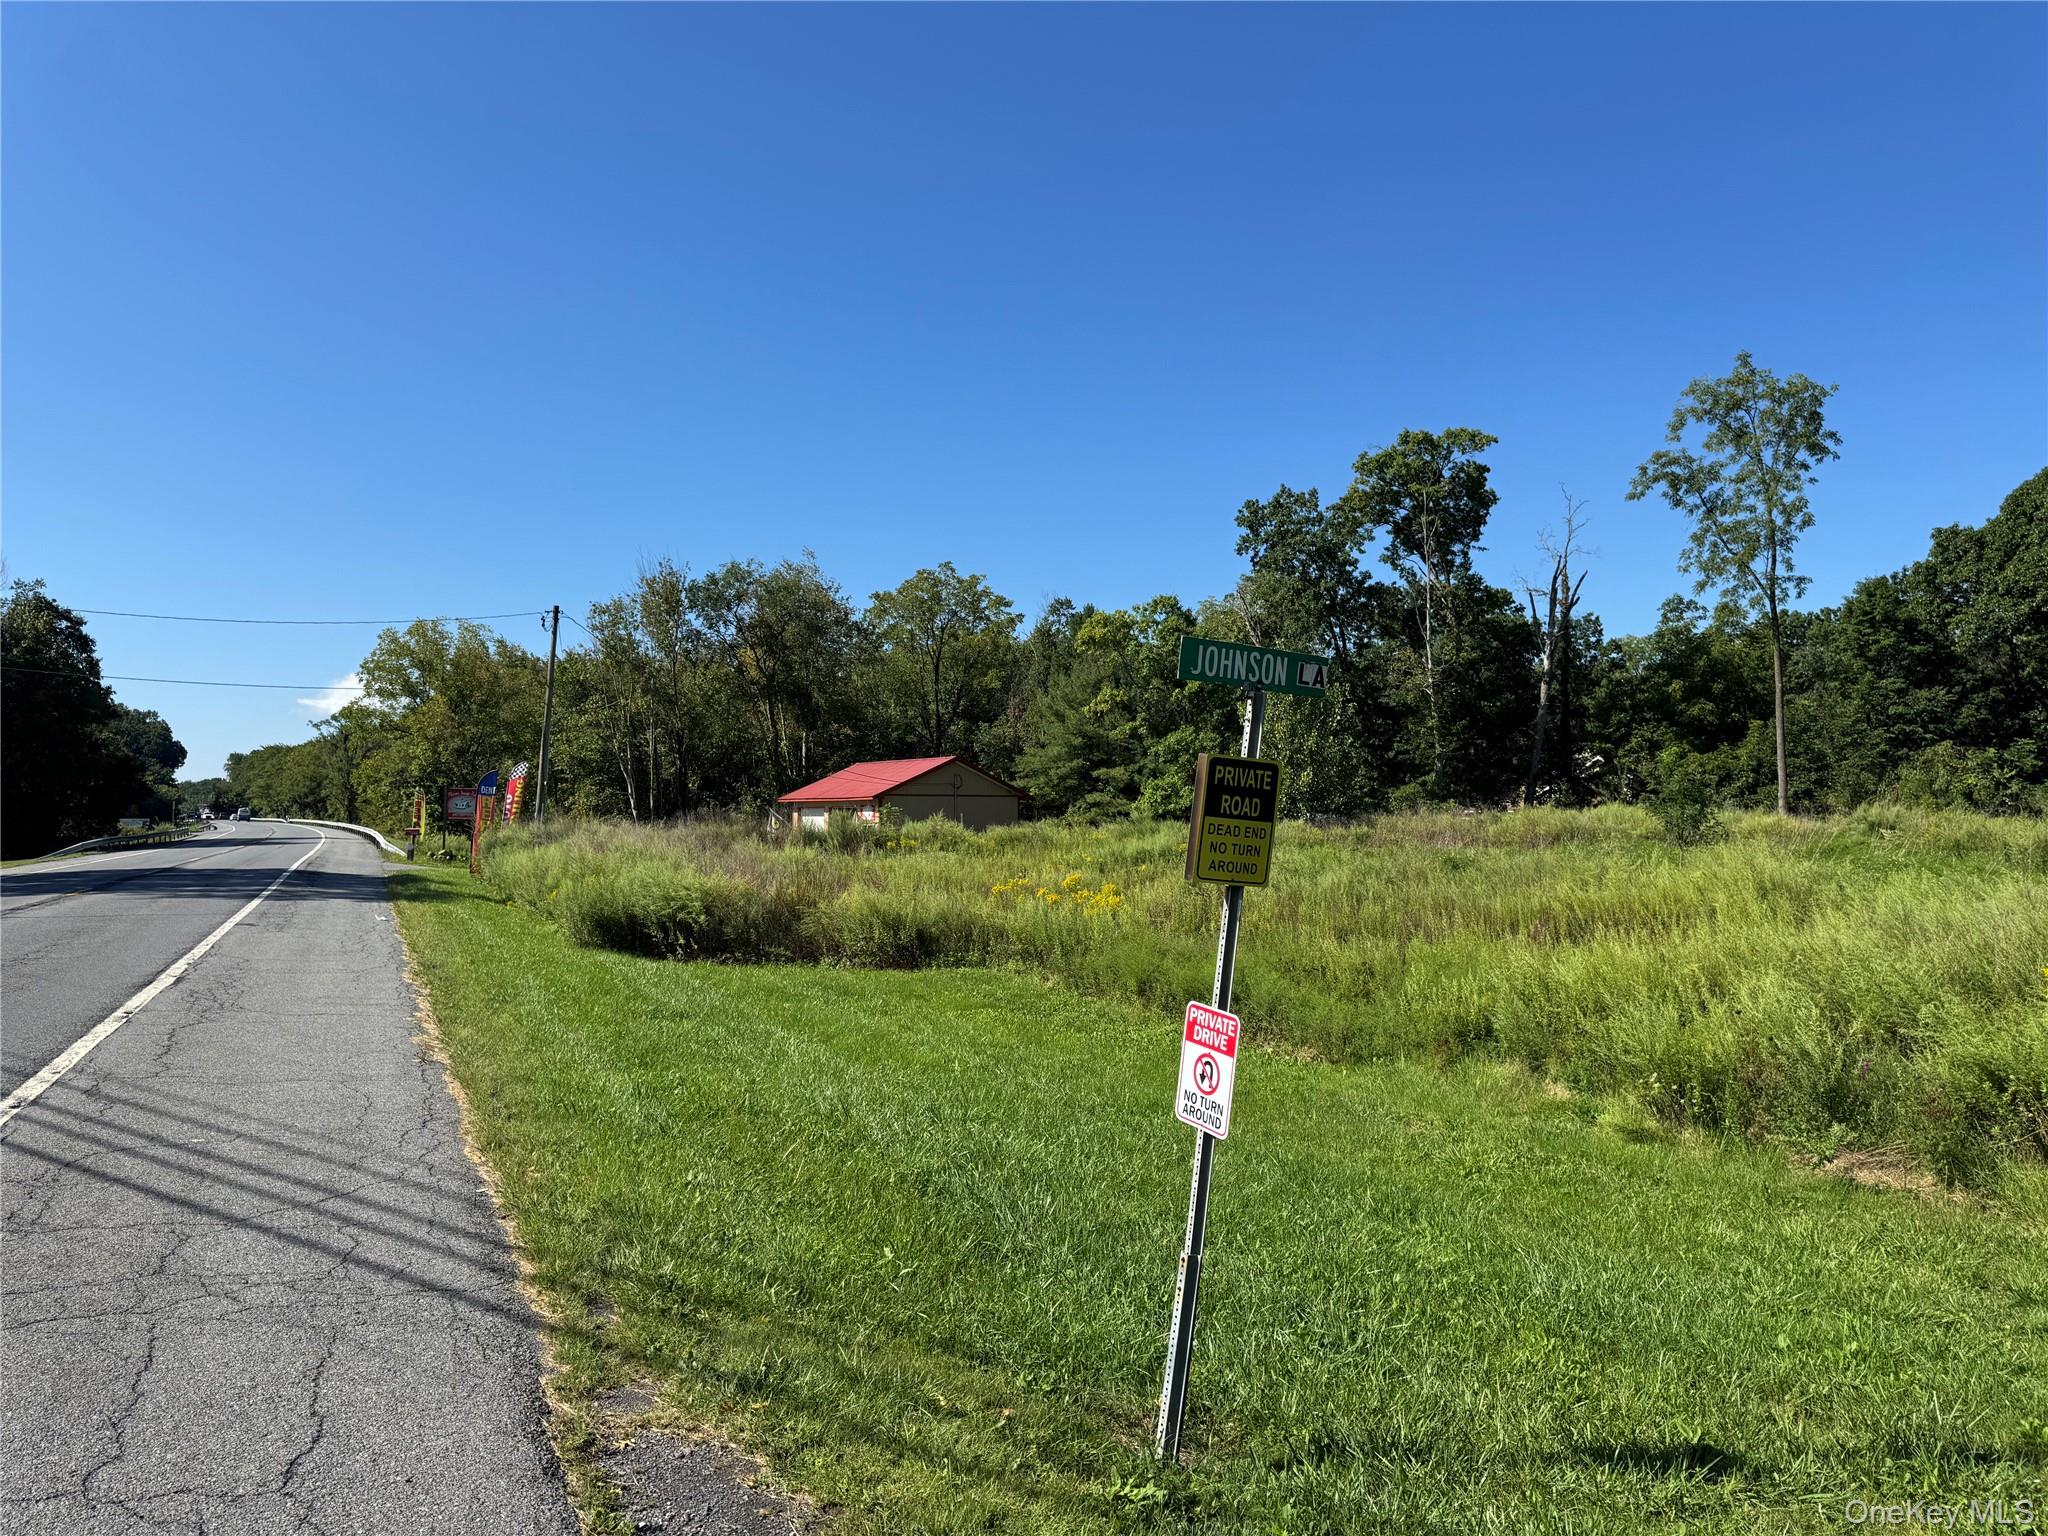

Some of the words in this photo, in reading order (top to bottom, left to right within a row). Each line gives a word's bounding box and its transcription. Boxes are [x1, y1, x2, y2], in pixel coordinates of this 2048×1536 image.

[1190, 645, 1288, 686] JOHNSON
[1298, 663, 1325, 688] LA
[1214, 765, 1272, 790] PRIVATE
[481, 786, 496, 795] DENT
[1220, 794, 1261, 817] ROAD
[1207, 823, 1240, 838] DEAD
[1244, 826, 1267, 840] END
[1209, 841, 1227, 854] NO
[1231, 843, 1260, 857] TURN
[1208, 860, 1258, 875] AROUND
[1189, 1007, 1236, 1037] PRIVATE
[1193, 1025, 1229, 1051] DRIVE
[1183, 1089, 1198, 1104] NO
[1200, 1095, 1224, 1117] TURN
[1182, 1103, 1222, 1129] AROUND
